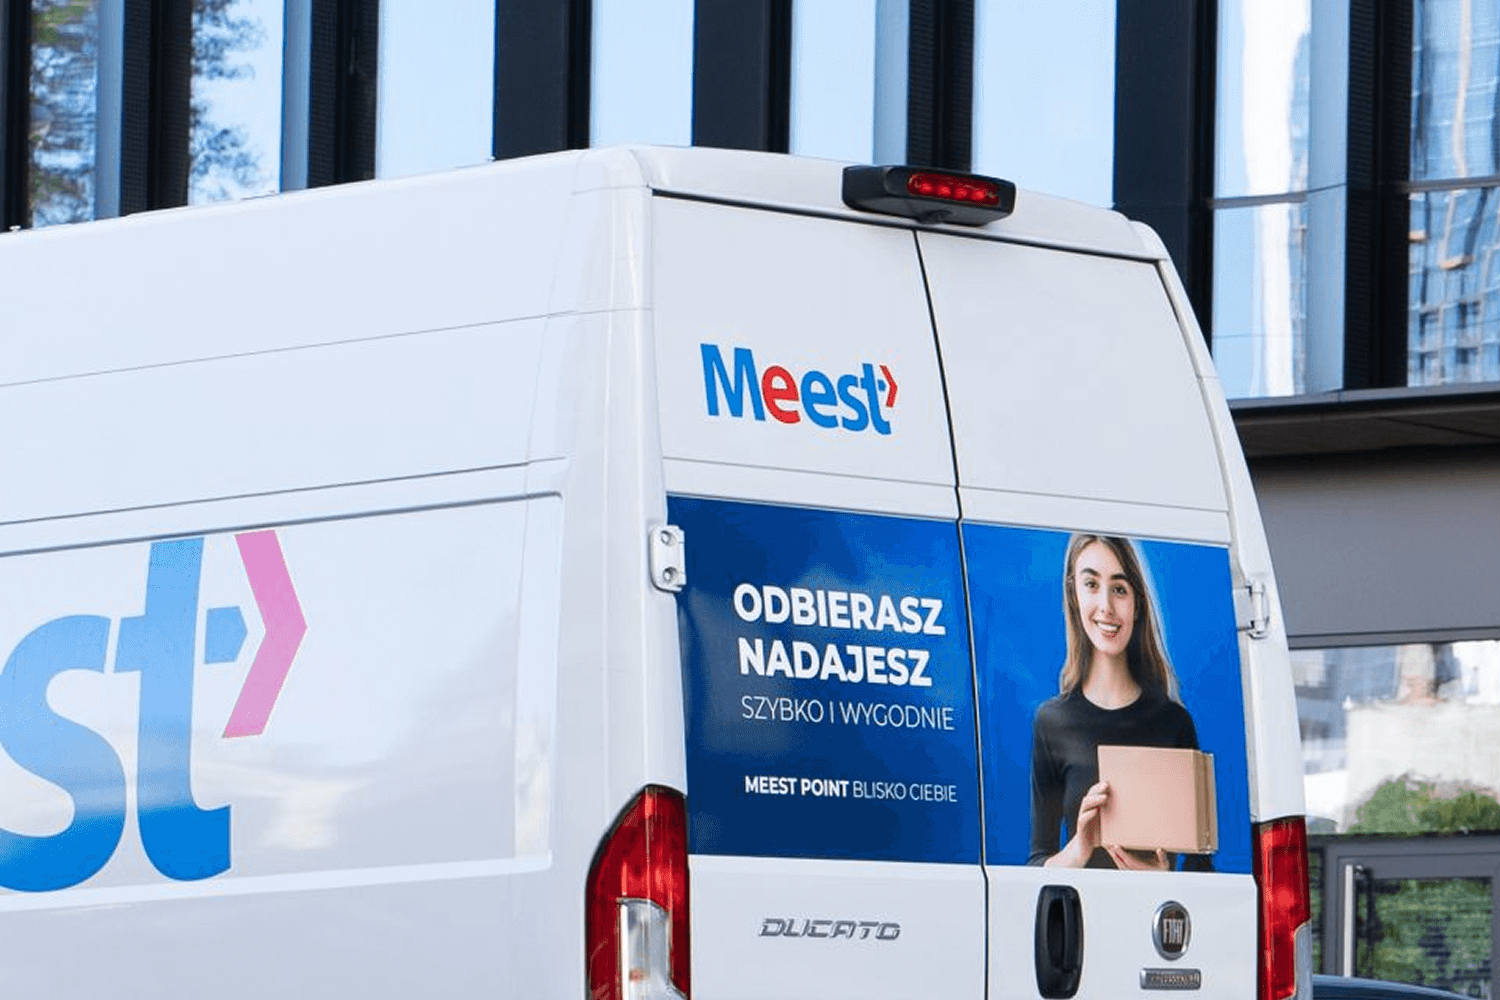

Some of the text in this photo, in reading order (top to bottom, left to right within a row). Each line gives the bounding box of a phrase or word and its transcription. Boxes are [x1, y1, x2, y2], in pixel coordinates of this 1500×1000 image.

[700, 343, 892, 435] Meest
[733, 583, 946, 635] ODBIERASZ
[738, 637, 933, 687] NADAJESZ
[741, 695, 955, 730] SZYBKO I WYGODNIE
[745, 775, 958, 802] MEEST POINT BLISKO CIEBIE
[758, 917, 901, 940] DUCATO
[1163, 917, 1184, 944] FIAT
